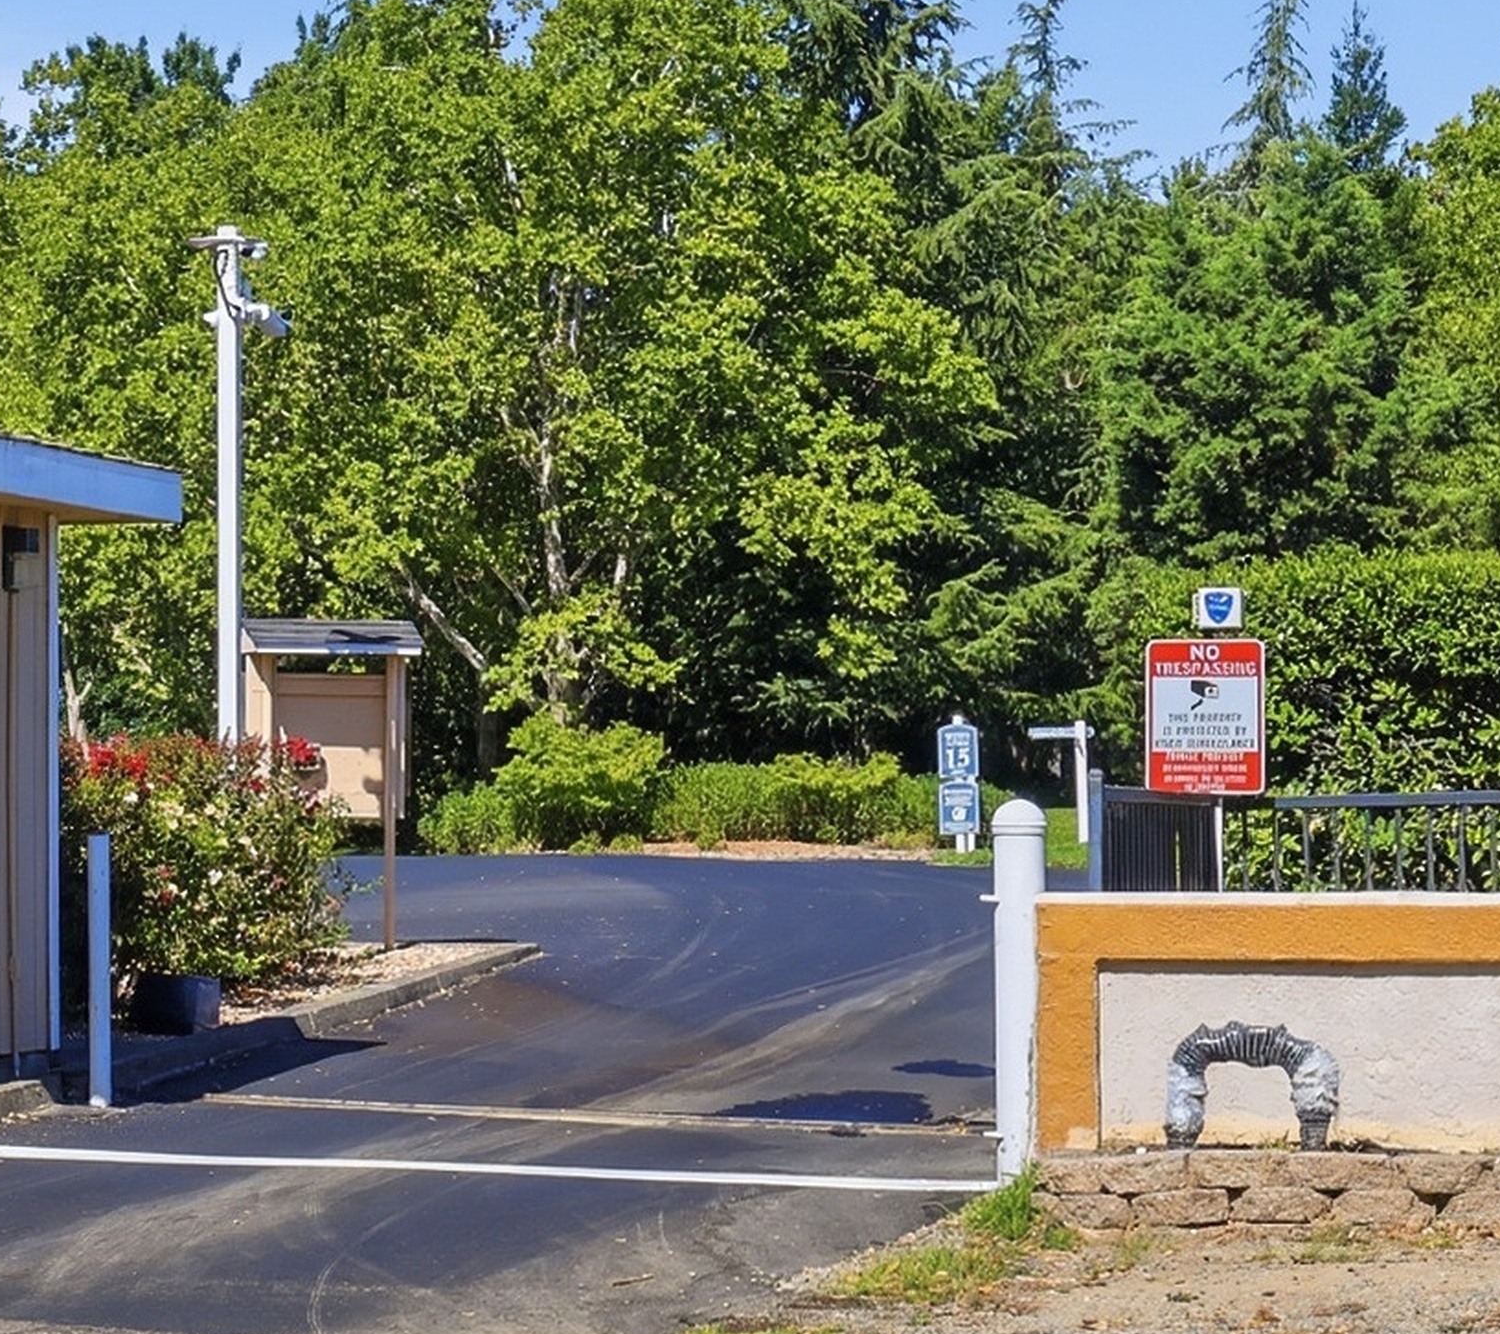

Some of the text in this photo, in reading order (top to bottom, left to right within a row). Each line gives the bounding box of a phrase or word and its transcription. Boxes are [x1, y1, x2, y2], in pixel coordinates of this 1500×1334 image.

[1189, 644, 1220, 661] NO
[1155, 662, 1257, 675] TRESPASSING
[946, 747, 970, 769] 15
